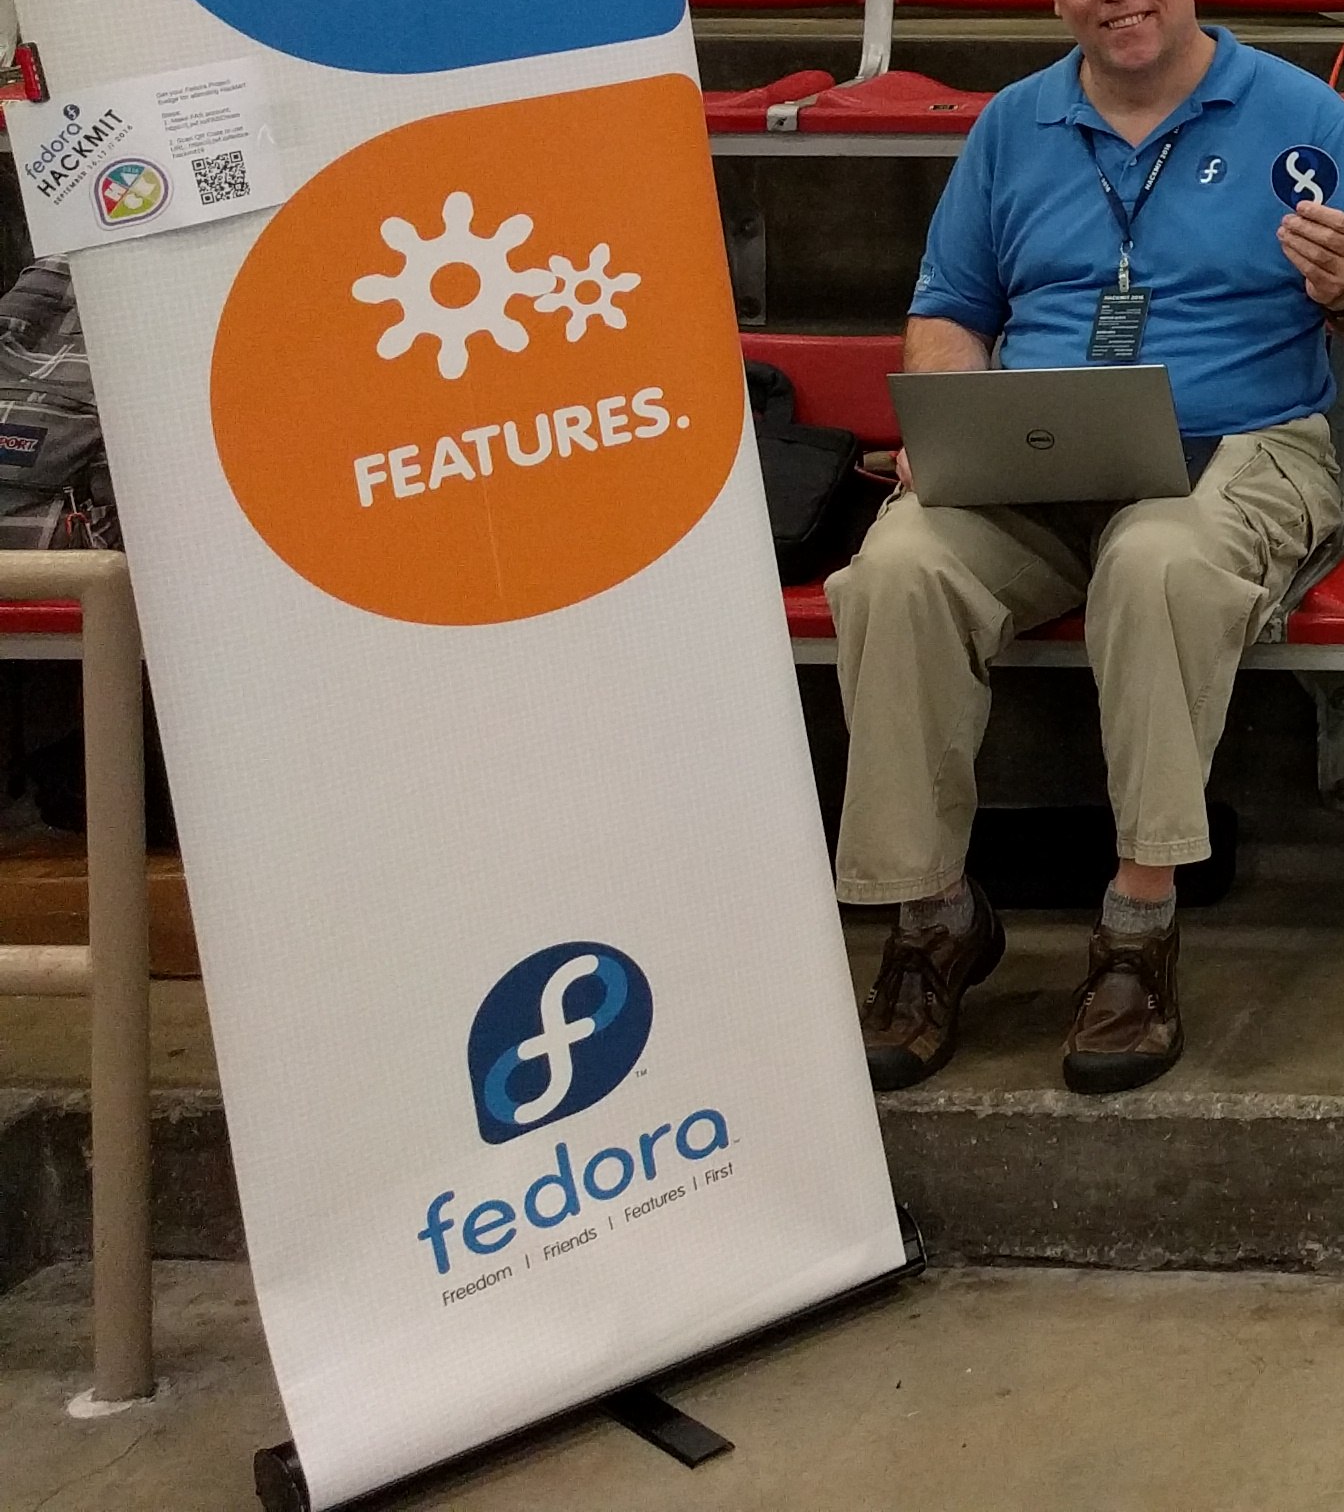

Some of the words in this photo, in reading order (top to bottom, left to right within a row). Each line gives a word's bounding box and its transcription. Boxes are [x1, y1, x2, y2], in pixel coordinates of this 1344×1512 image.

[25, 123, 82, 179] fedora
[37, 109, 123, 197] HACKMIT
[53, 172, 87, 206] SEPTEMBER
[354, 387, 690, 507] FEATURES.
[417, 1108, 729, 1275] fedora
[442, 1265, 513, 1306] Freedom
[543, 1224, 598, 1261] Friends
[624, 1184, 687, 1223] Features
[705, 1162, 734, 1185] First
